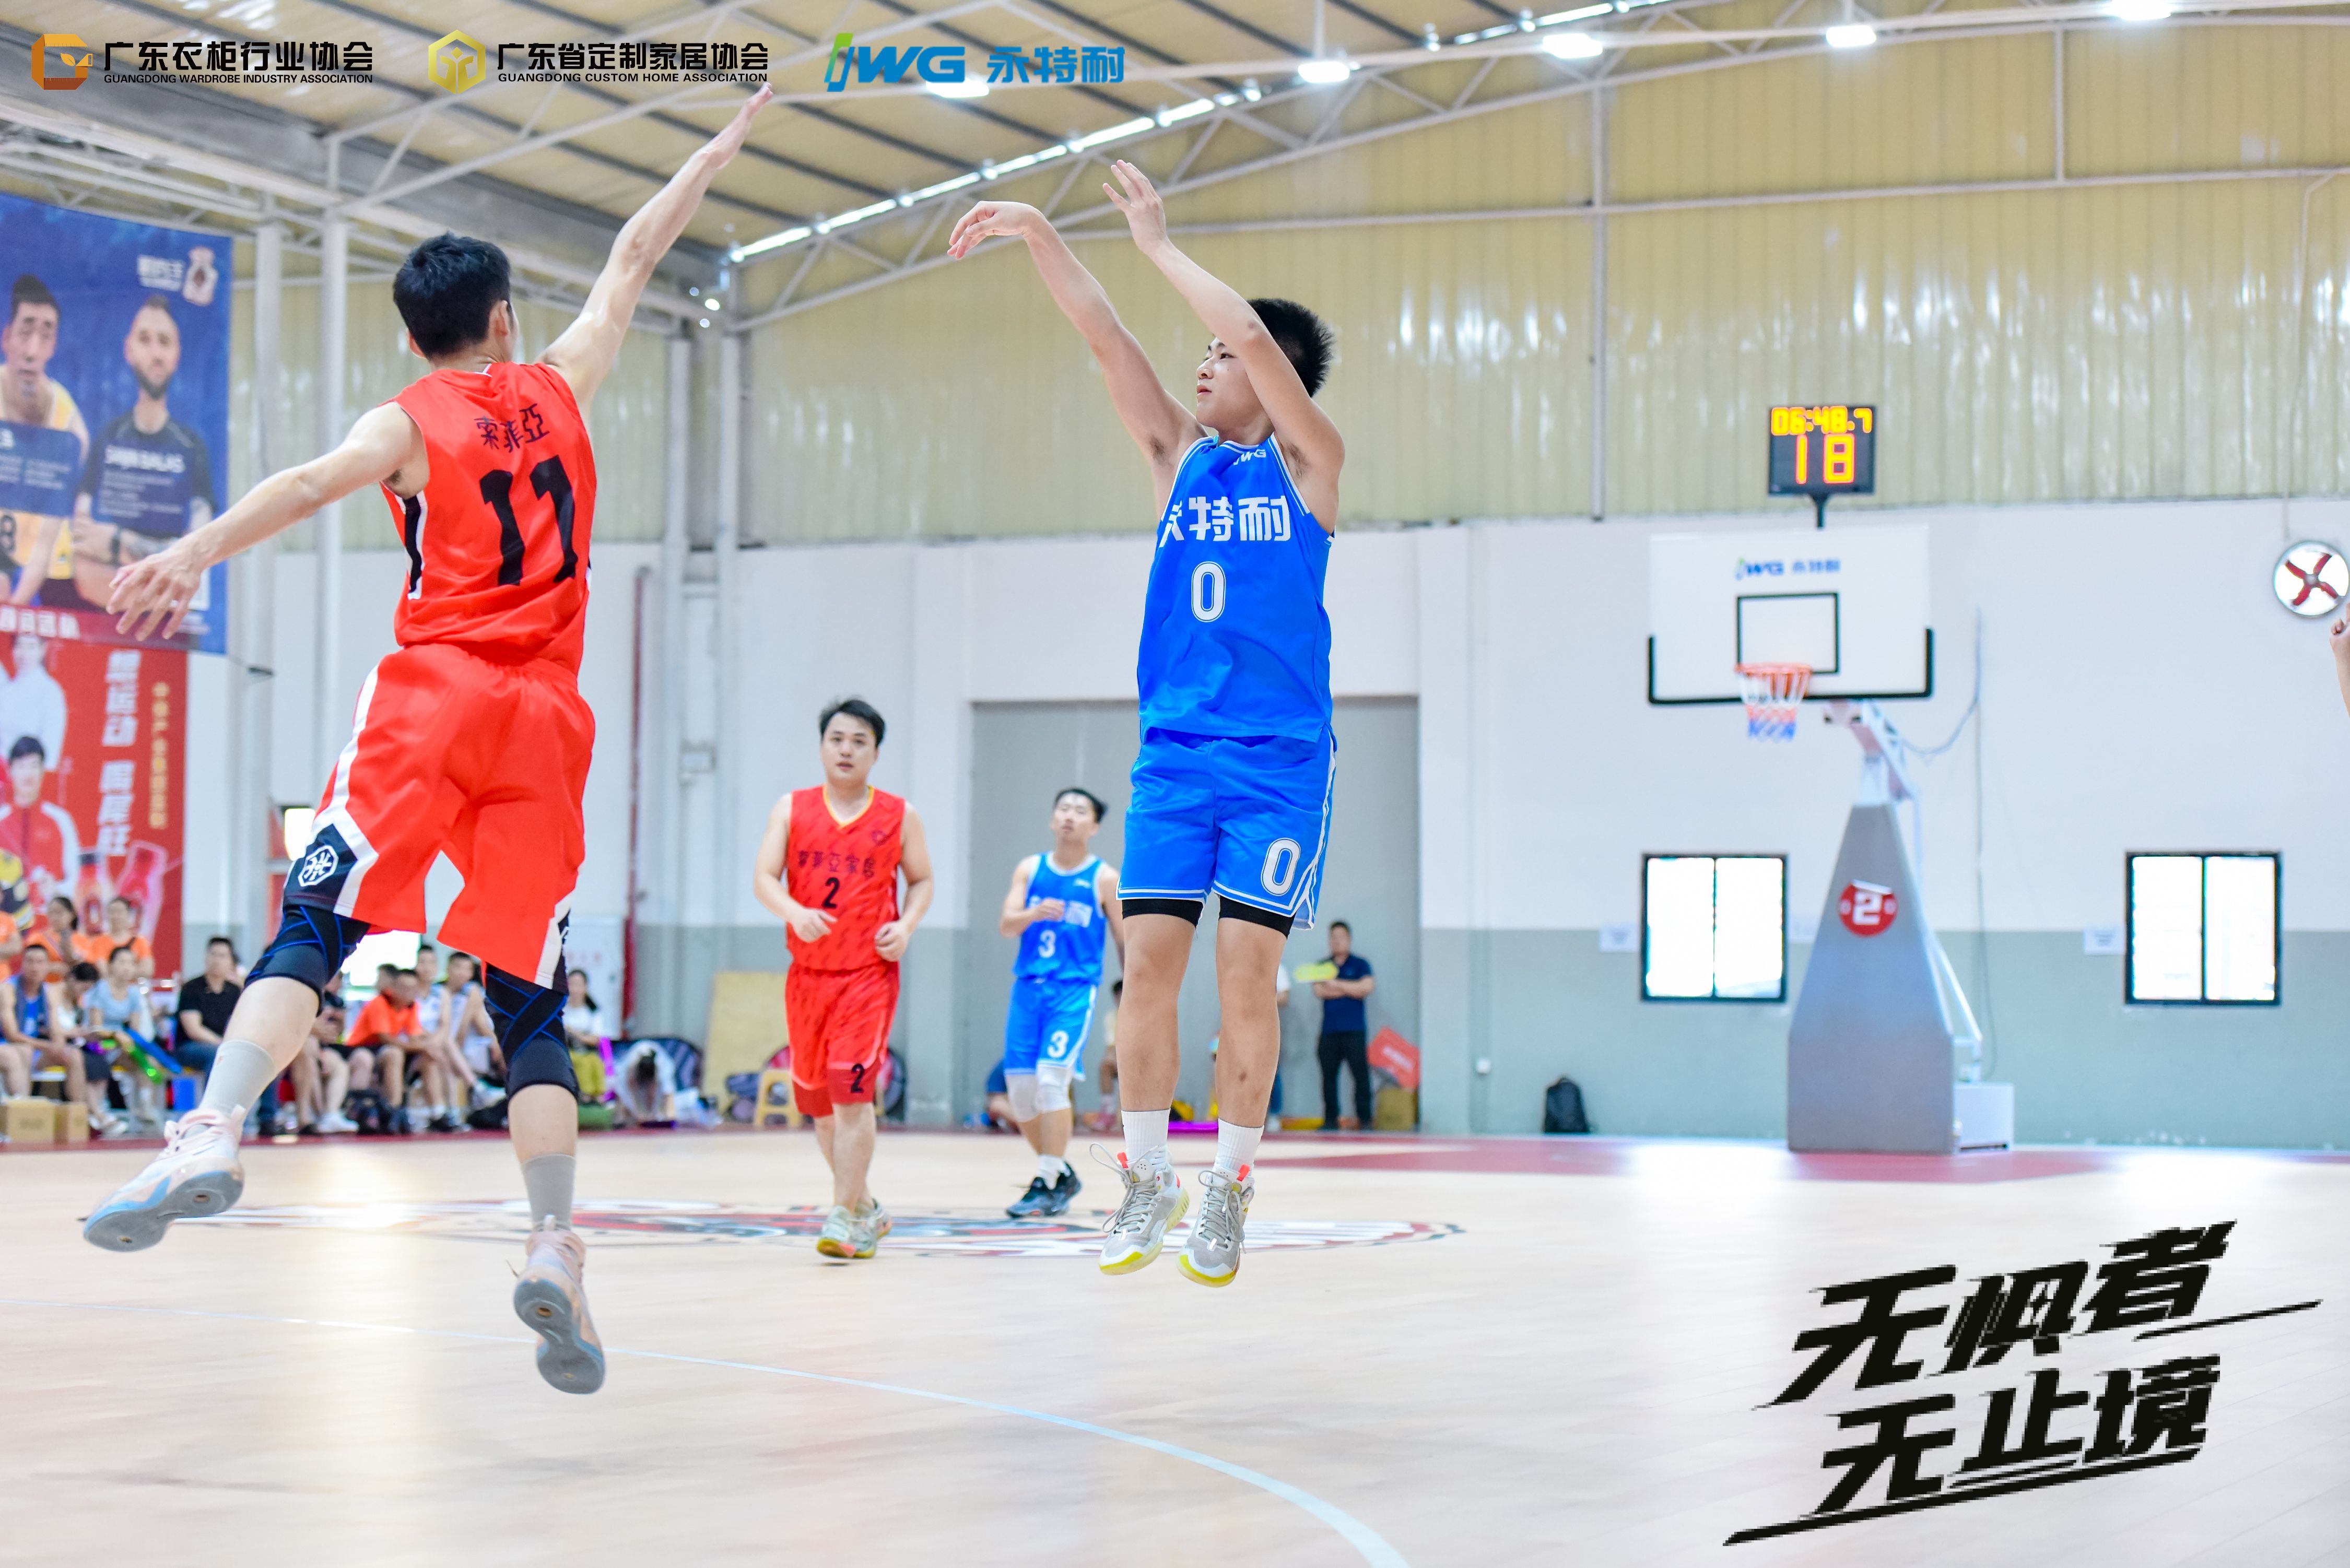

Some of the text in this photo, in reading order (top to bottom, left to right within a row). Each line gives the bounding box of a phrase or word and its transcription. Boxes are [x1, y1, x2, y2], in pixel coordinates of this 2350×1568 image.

[1795, 433, 1855, 485] 18
[479, 455, 578, 586] 11
[1191, 561, 1226, 622] 0
[1261, 838, 1301, 896] 0
[822, 877, 840, 909] 2
[1853, 891, 1881, 925] 2
[1038, 929, 1056, 958] 3
[1047, 1031, 1069, 1058] 3
[850, 1063, 865, 1094] 2
